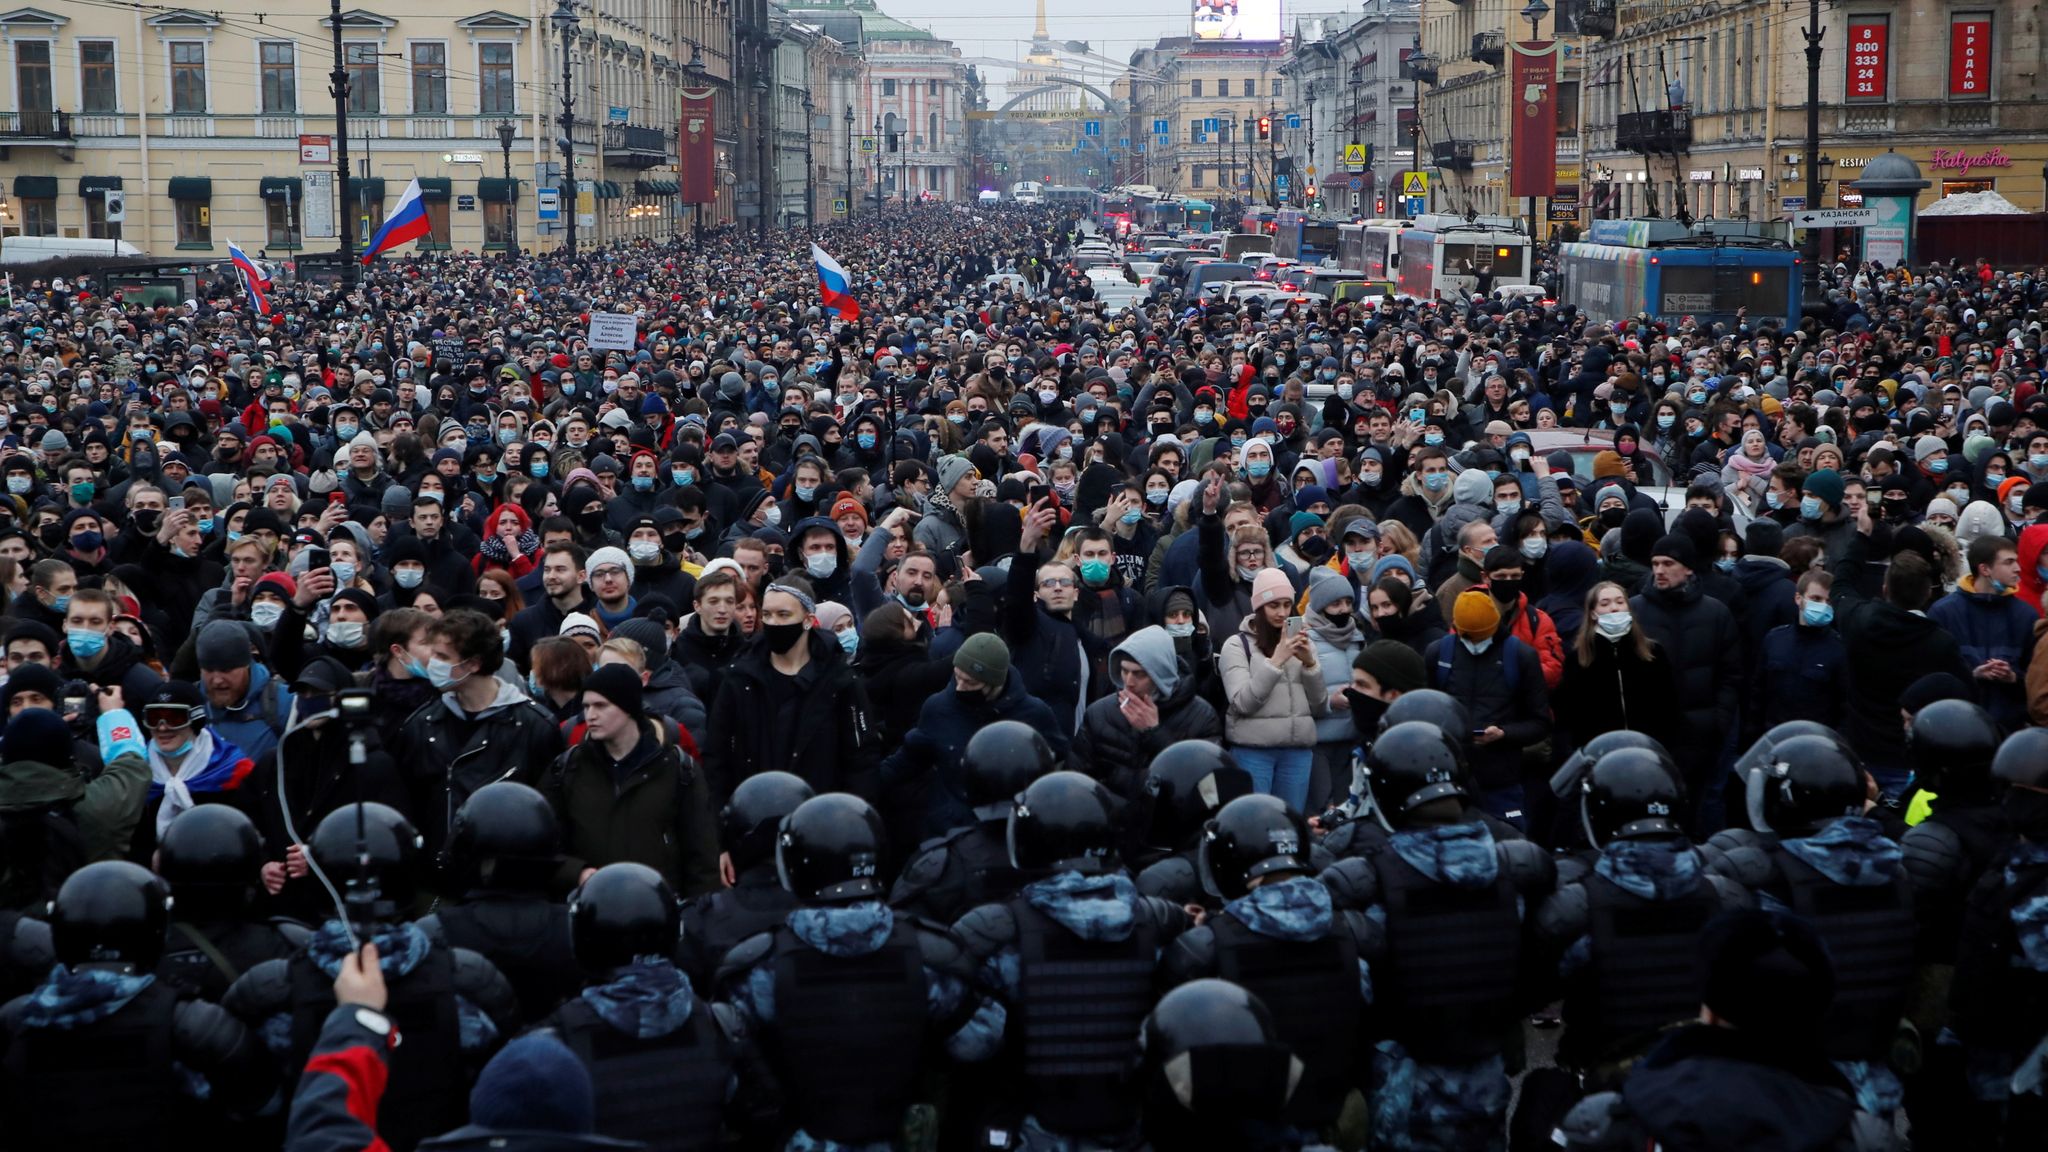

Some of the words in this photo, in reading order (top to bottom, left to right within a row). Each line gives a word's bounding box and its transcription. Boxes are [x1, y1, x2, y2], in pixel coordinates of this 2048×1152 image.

[1863, 29, 1872, 39] 8
[1855, 42, 1879, 52] 800
[1855, 56, 1878, 65] 333
[1963, 25, 1975, 90] ПРОДАЮ
[1858, 69, 1874, 79] 24
[1858, 83, 1873, 92] 31
[1026, 110, 1047, 119] ДНЕЙ
[1059, 110, 1085, 118] НОЧЕЙ
[1820, 209, 1870, 219] КАЗАНСКАЯ
[1833, 218, 1857, 226] улица
